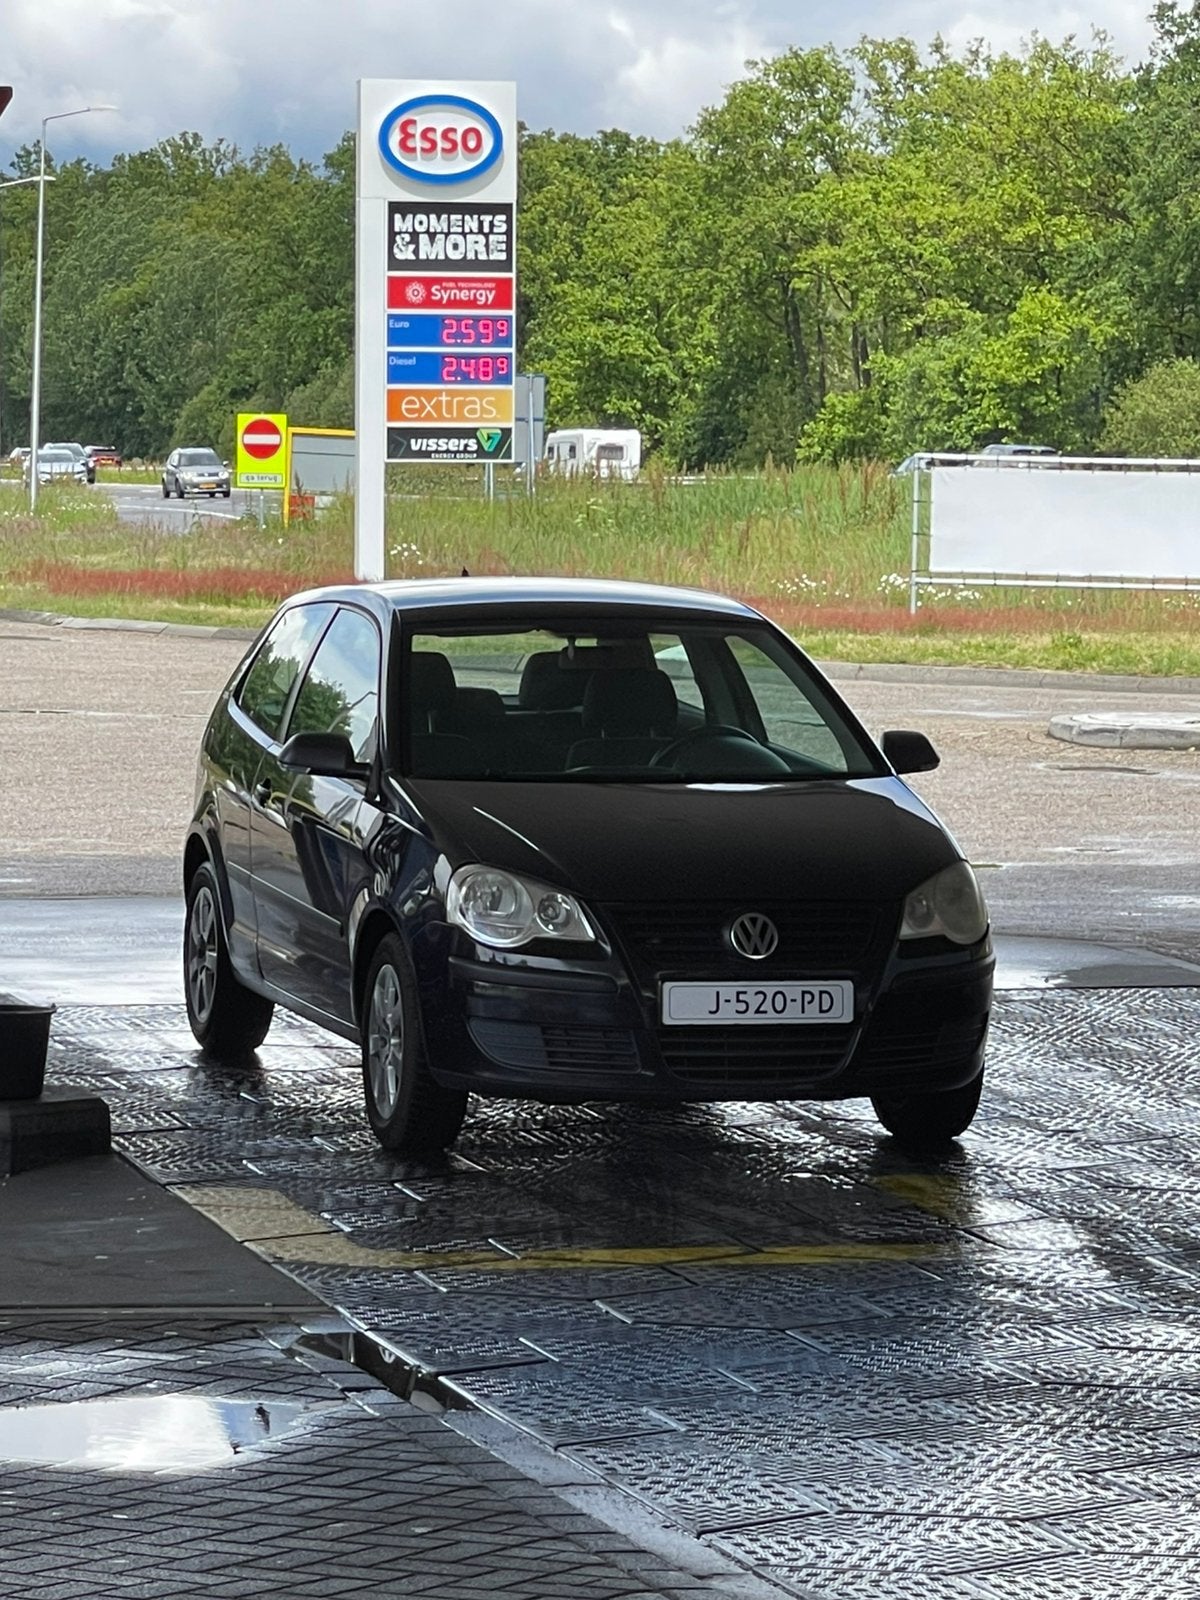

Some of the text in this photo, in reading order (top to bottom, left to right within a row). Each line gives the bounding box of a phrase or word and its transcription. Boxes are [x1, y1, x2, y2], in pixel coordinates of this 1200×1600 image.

[398, 118, 483, 154] Esso
[394, 213, 508, 233] MOMENTS
[431, 285, 496, 305] Synergy
[389, 320, 410, 328] Euro
[389, 357, 416, 365] Diesel
[708, 990, 834, 1015] J-520-PD
